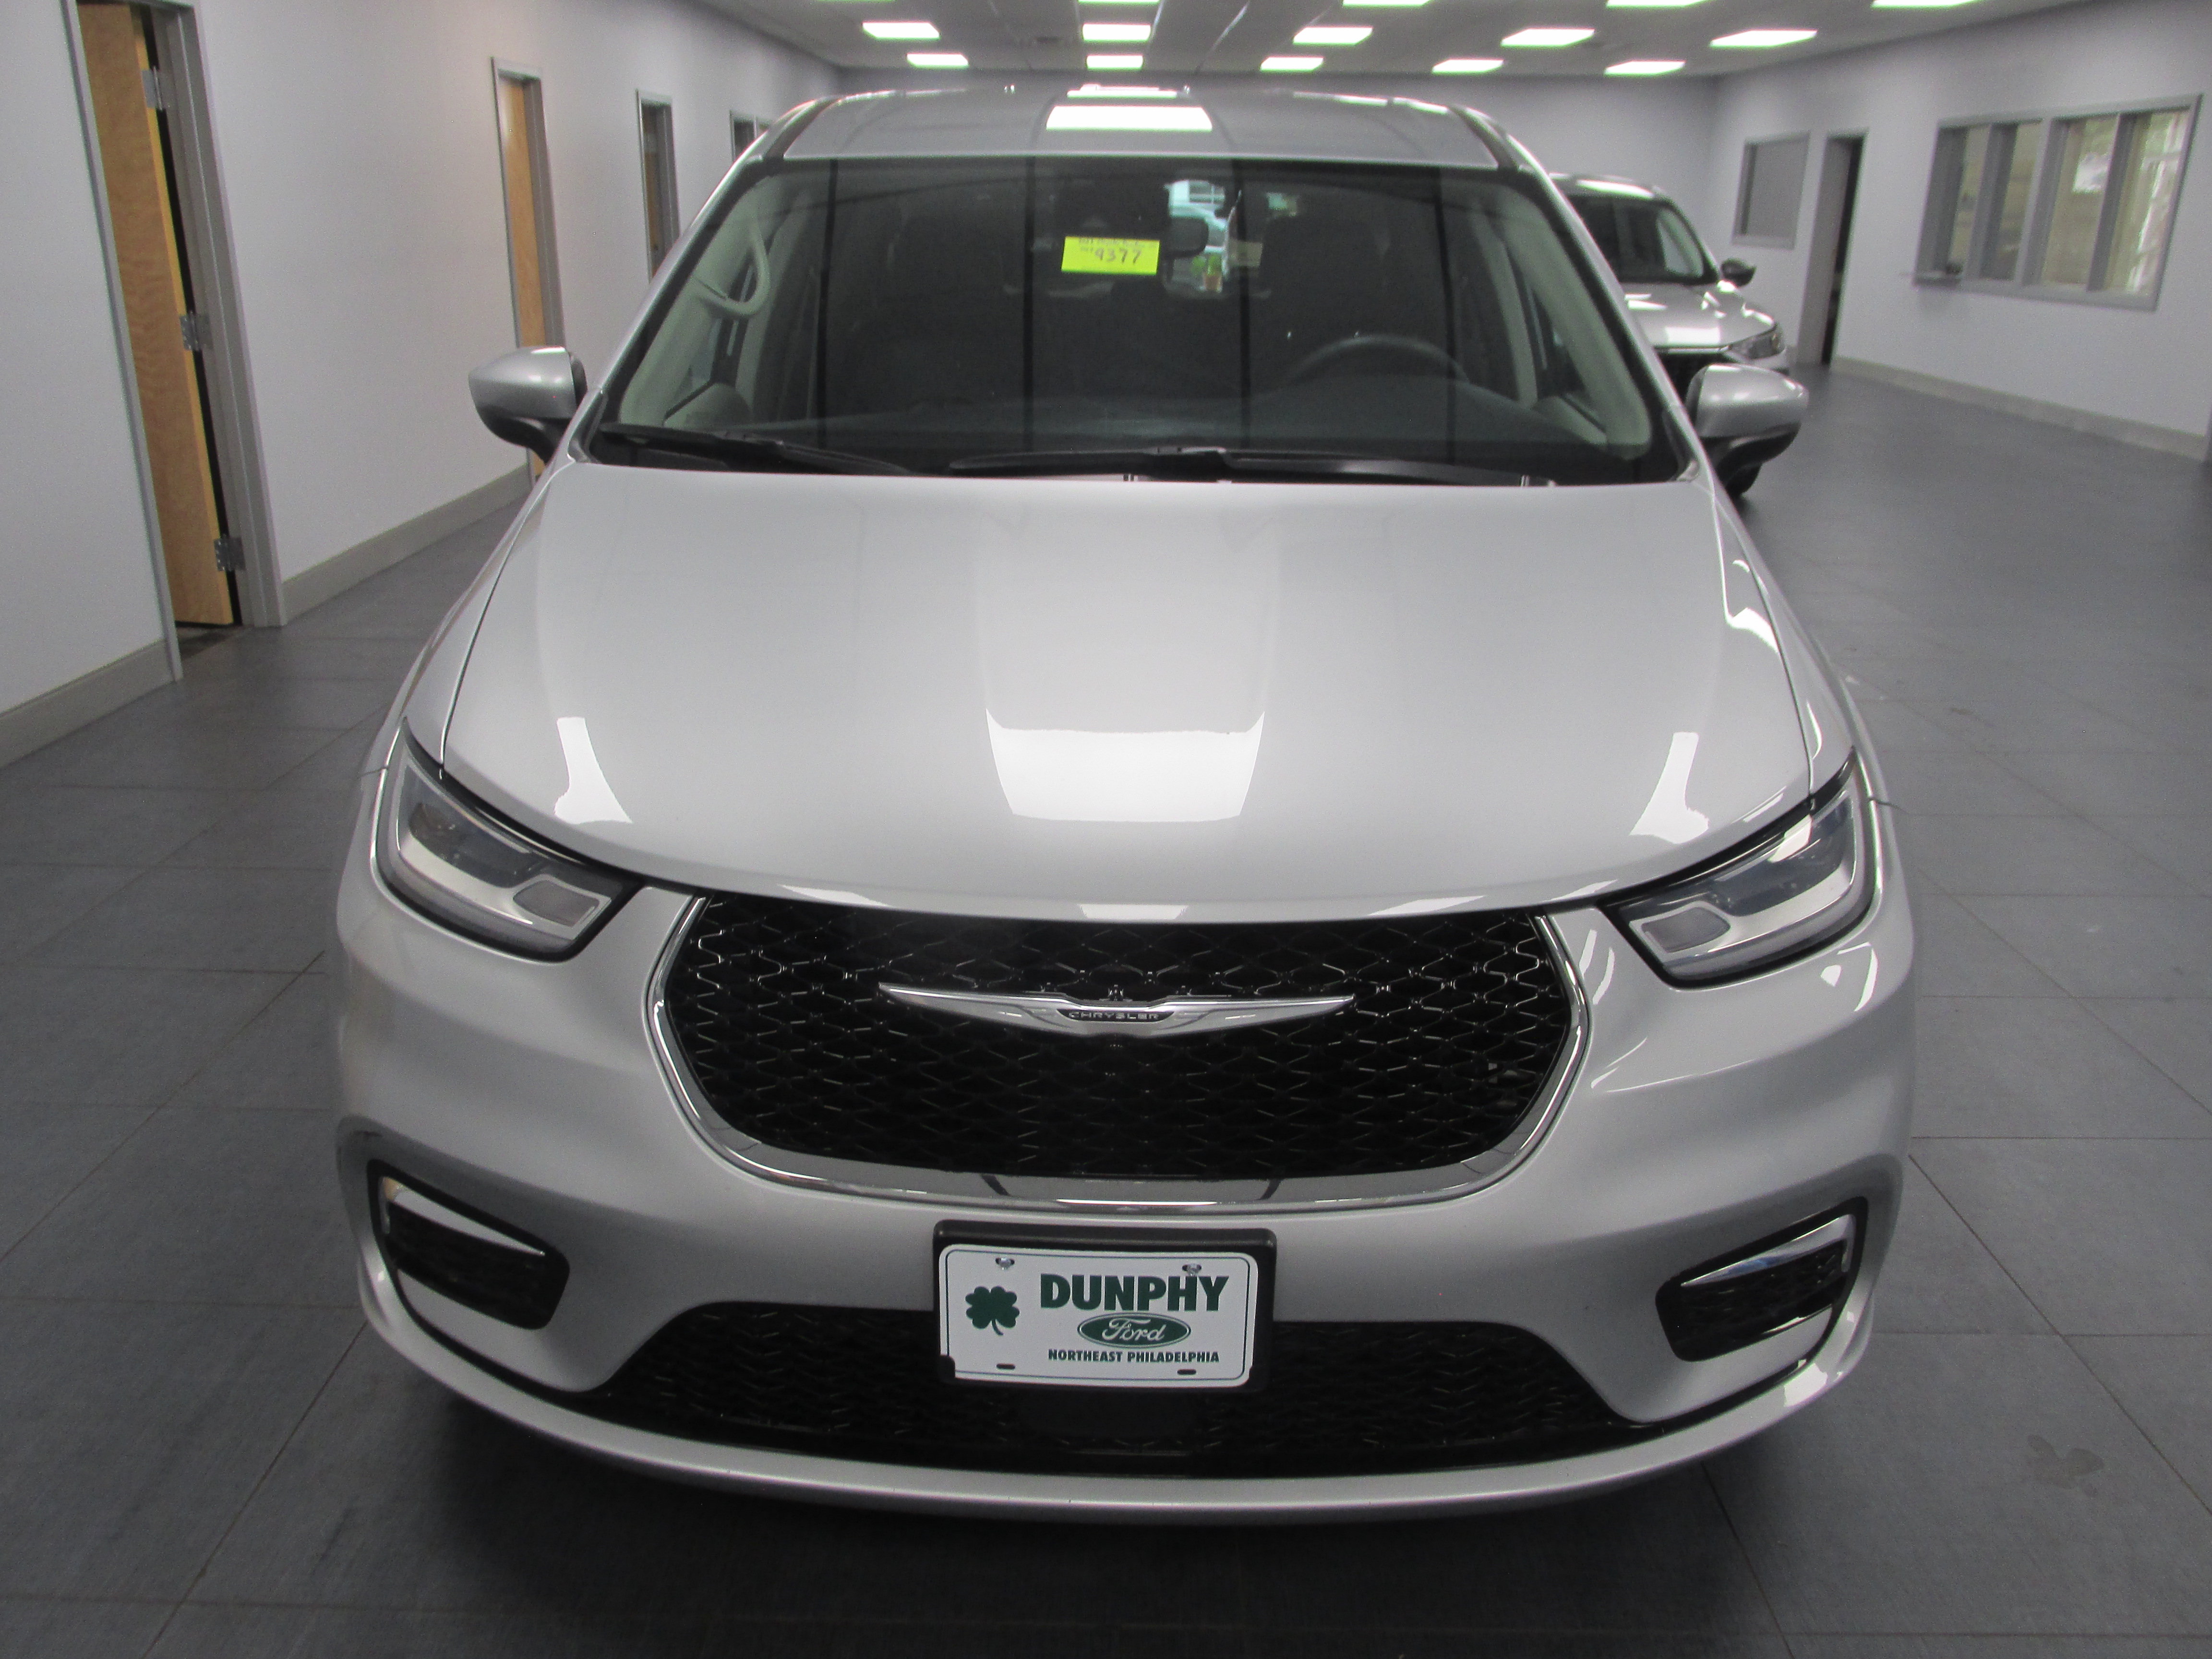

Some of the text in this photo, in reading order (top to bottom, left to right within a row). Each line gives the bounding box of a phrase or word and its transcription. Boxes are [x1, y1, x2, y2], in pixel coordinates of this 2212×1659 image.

[1069, 1011, 1159, 1020] CHRYSLER
[1040, 1274, 1229, 1311] DUNPHY
[1101, 1318, 1166, 1342] Ford
[1047, 1348, 1220, 1363] NORTHEAST PHILADELPHIA
